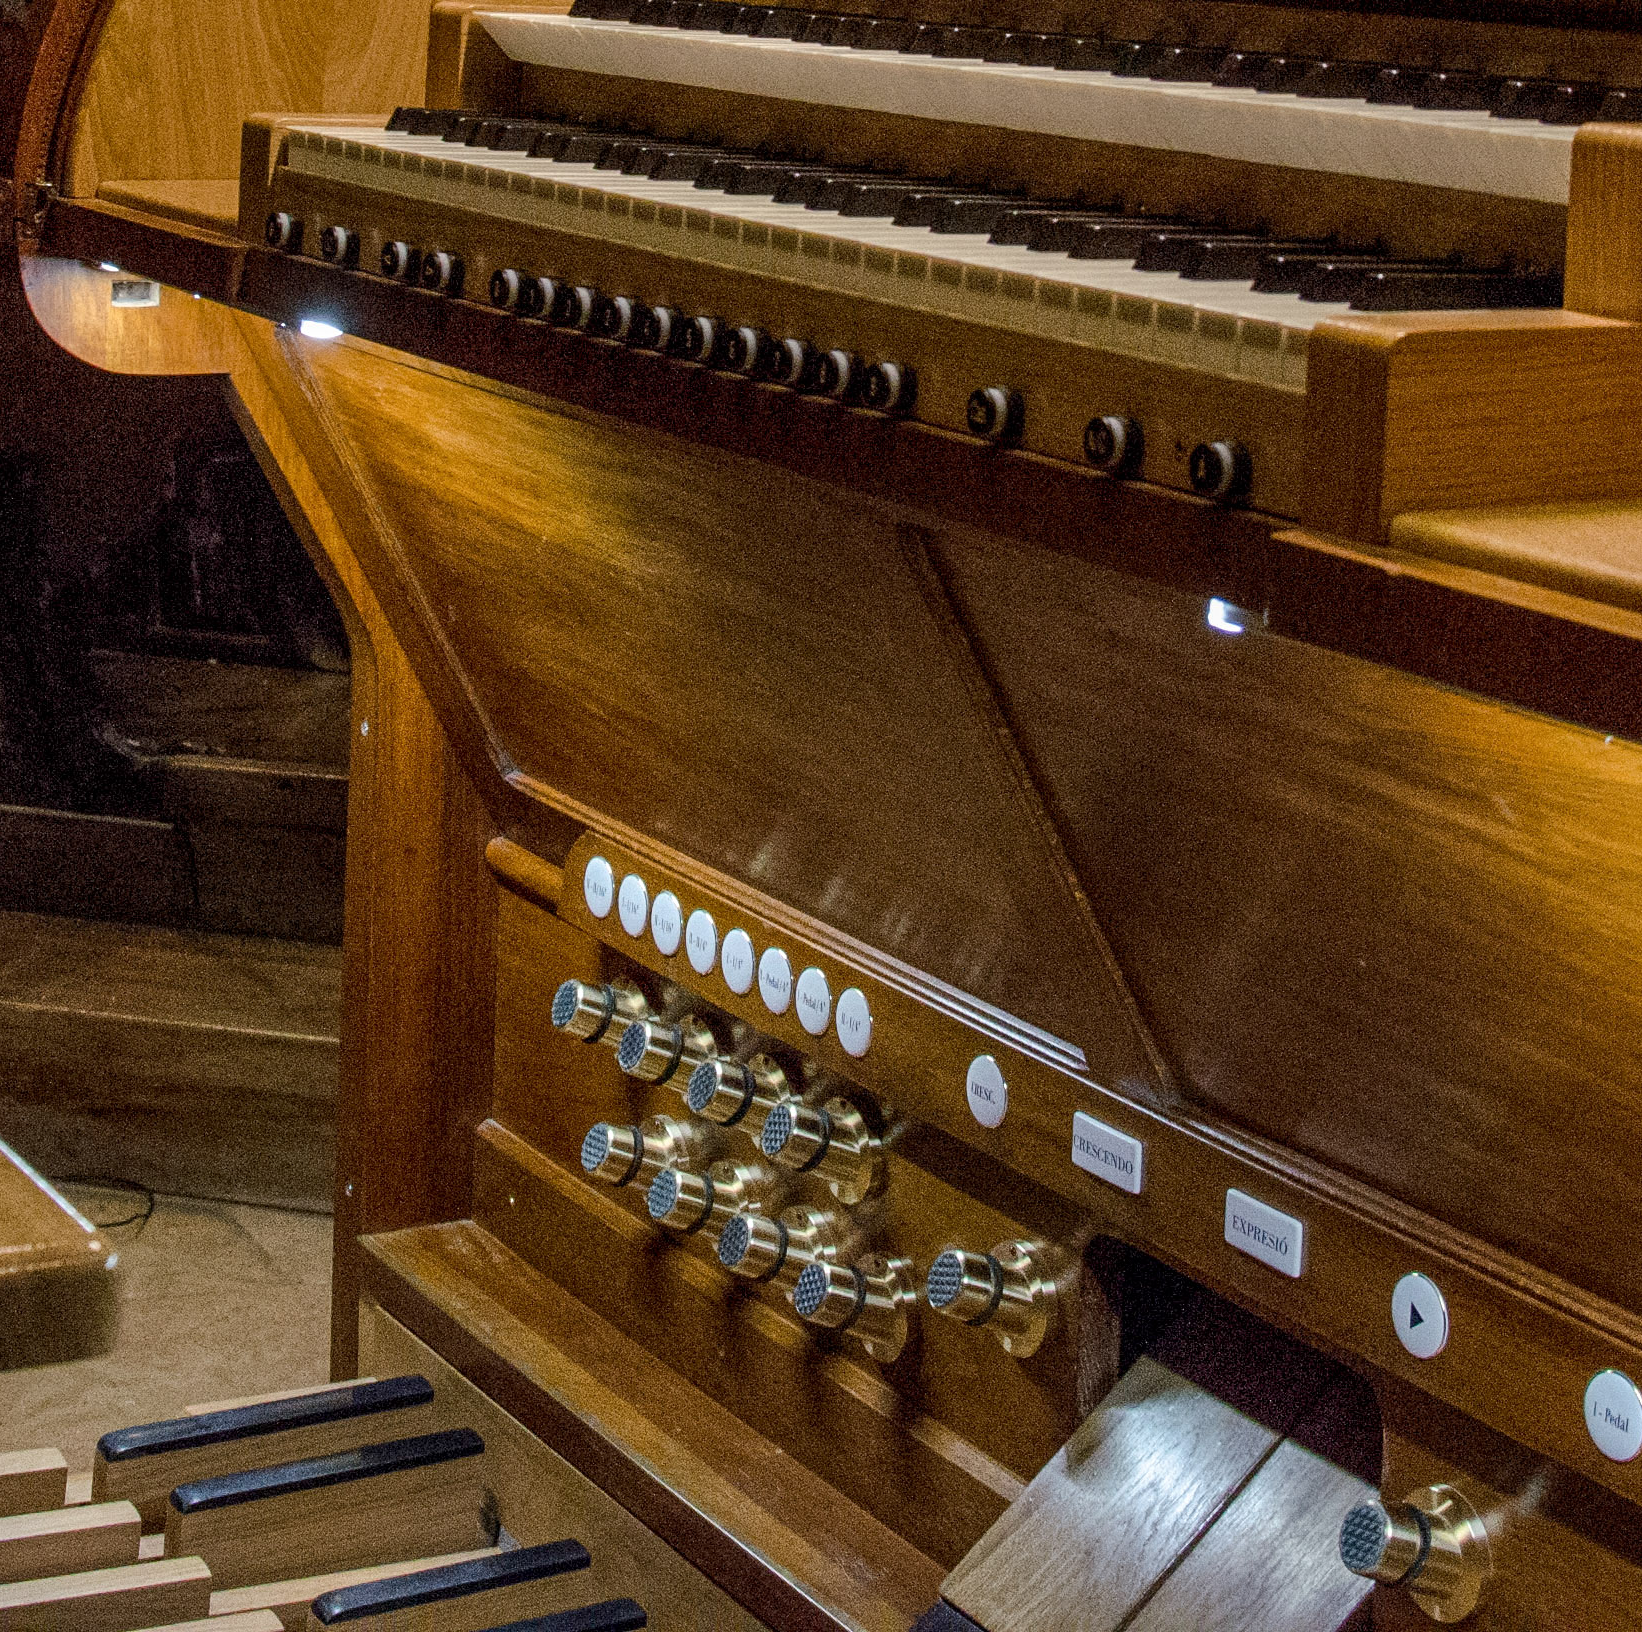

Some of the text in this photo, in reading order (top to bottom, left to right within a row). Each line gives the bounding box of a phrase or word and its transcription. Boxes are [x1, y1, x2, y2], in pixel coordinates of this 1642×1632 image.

[1073, 1134, 1134, 1175] CRESCENDO
[1232, 1214, 1288, 1256] EXPRESIÓ
[1604, 1407, 1629, 1433] Pedal
